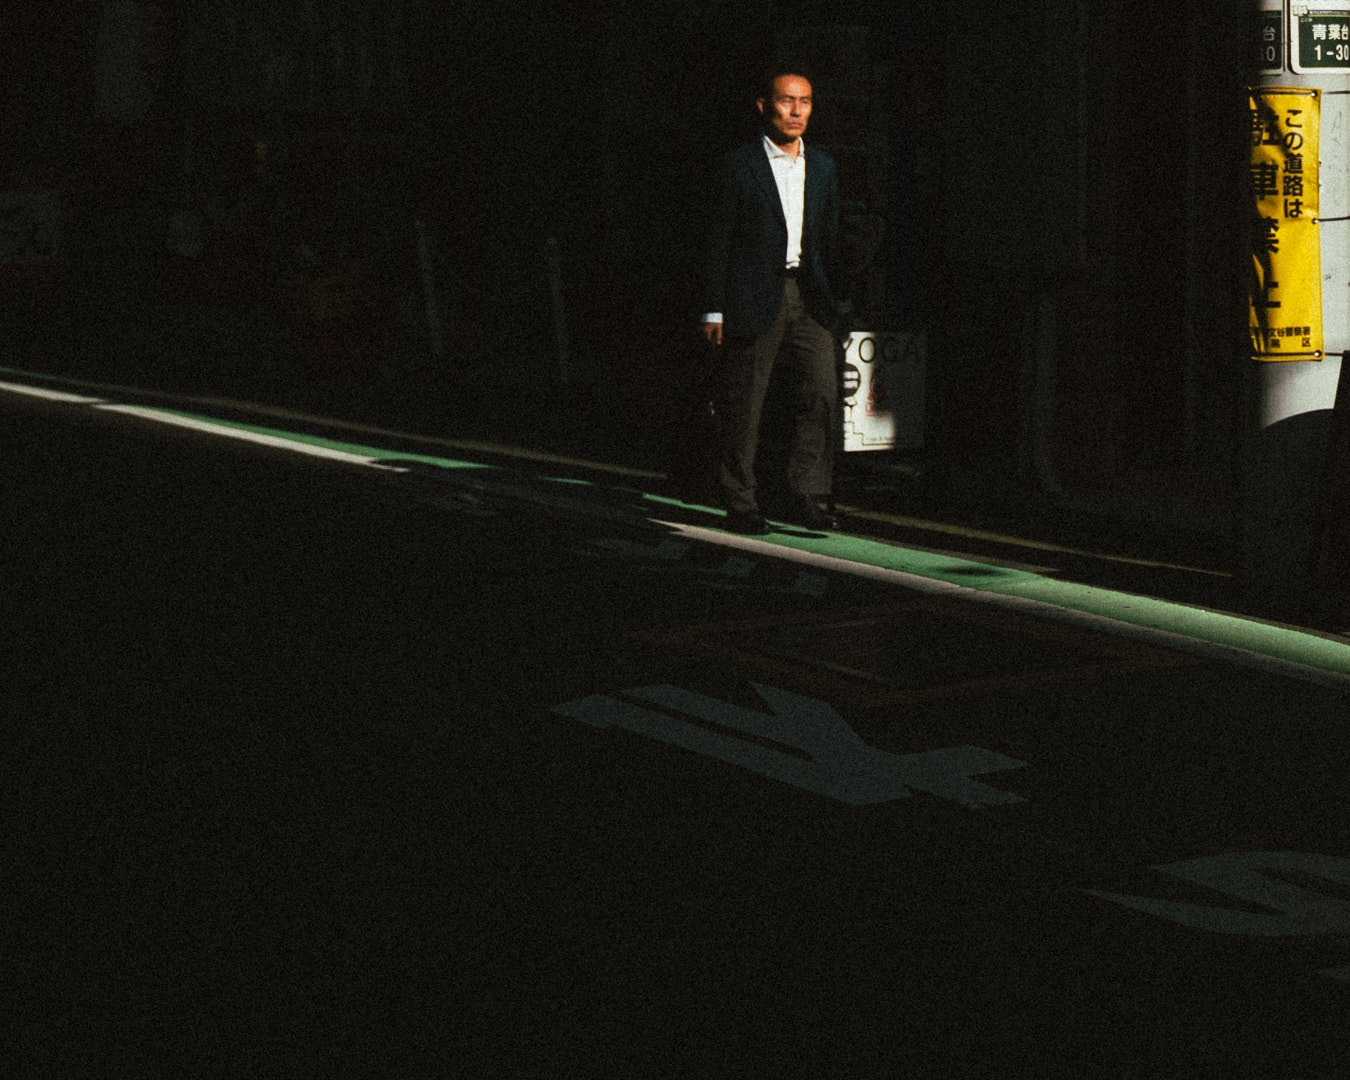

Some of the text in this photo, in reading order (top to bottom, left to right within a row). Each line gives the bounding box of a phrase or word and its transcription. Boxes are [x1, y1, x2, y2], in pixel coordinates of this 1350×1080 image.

[1311, 23, 1350, 41] 青葉台
[1314, 43, 1350, 61] 1-30
[1282, 109, 1304, 219] この道路は
